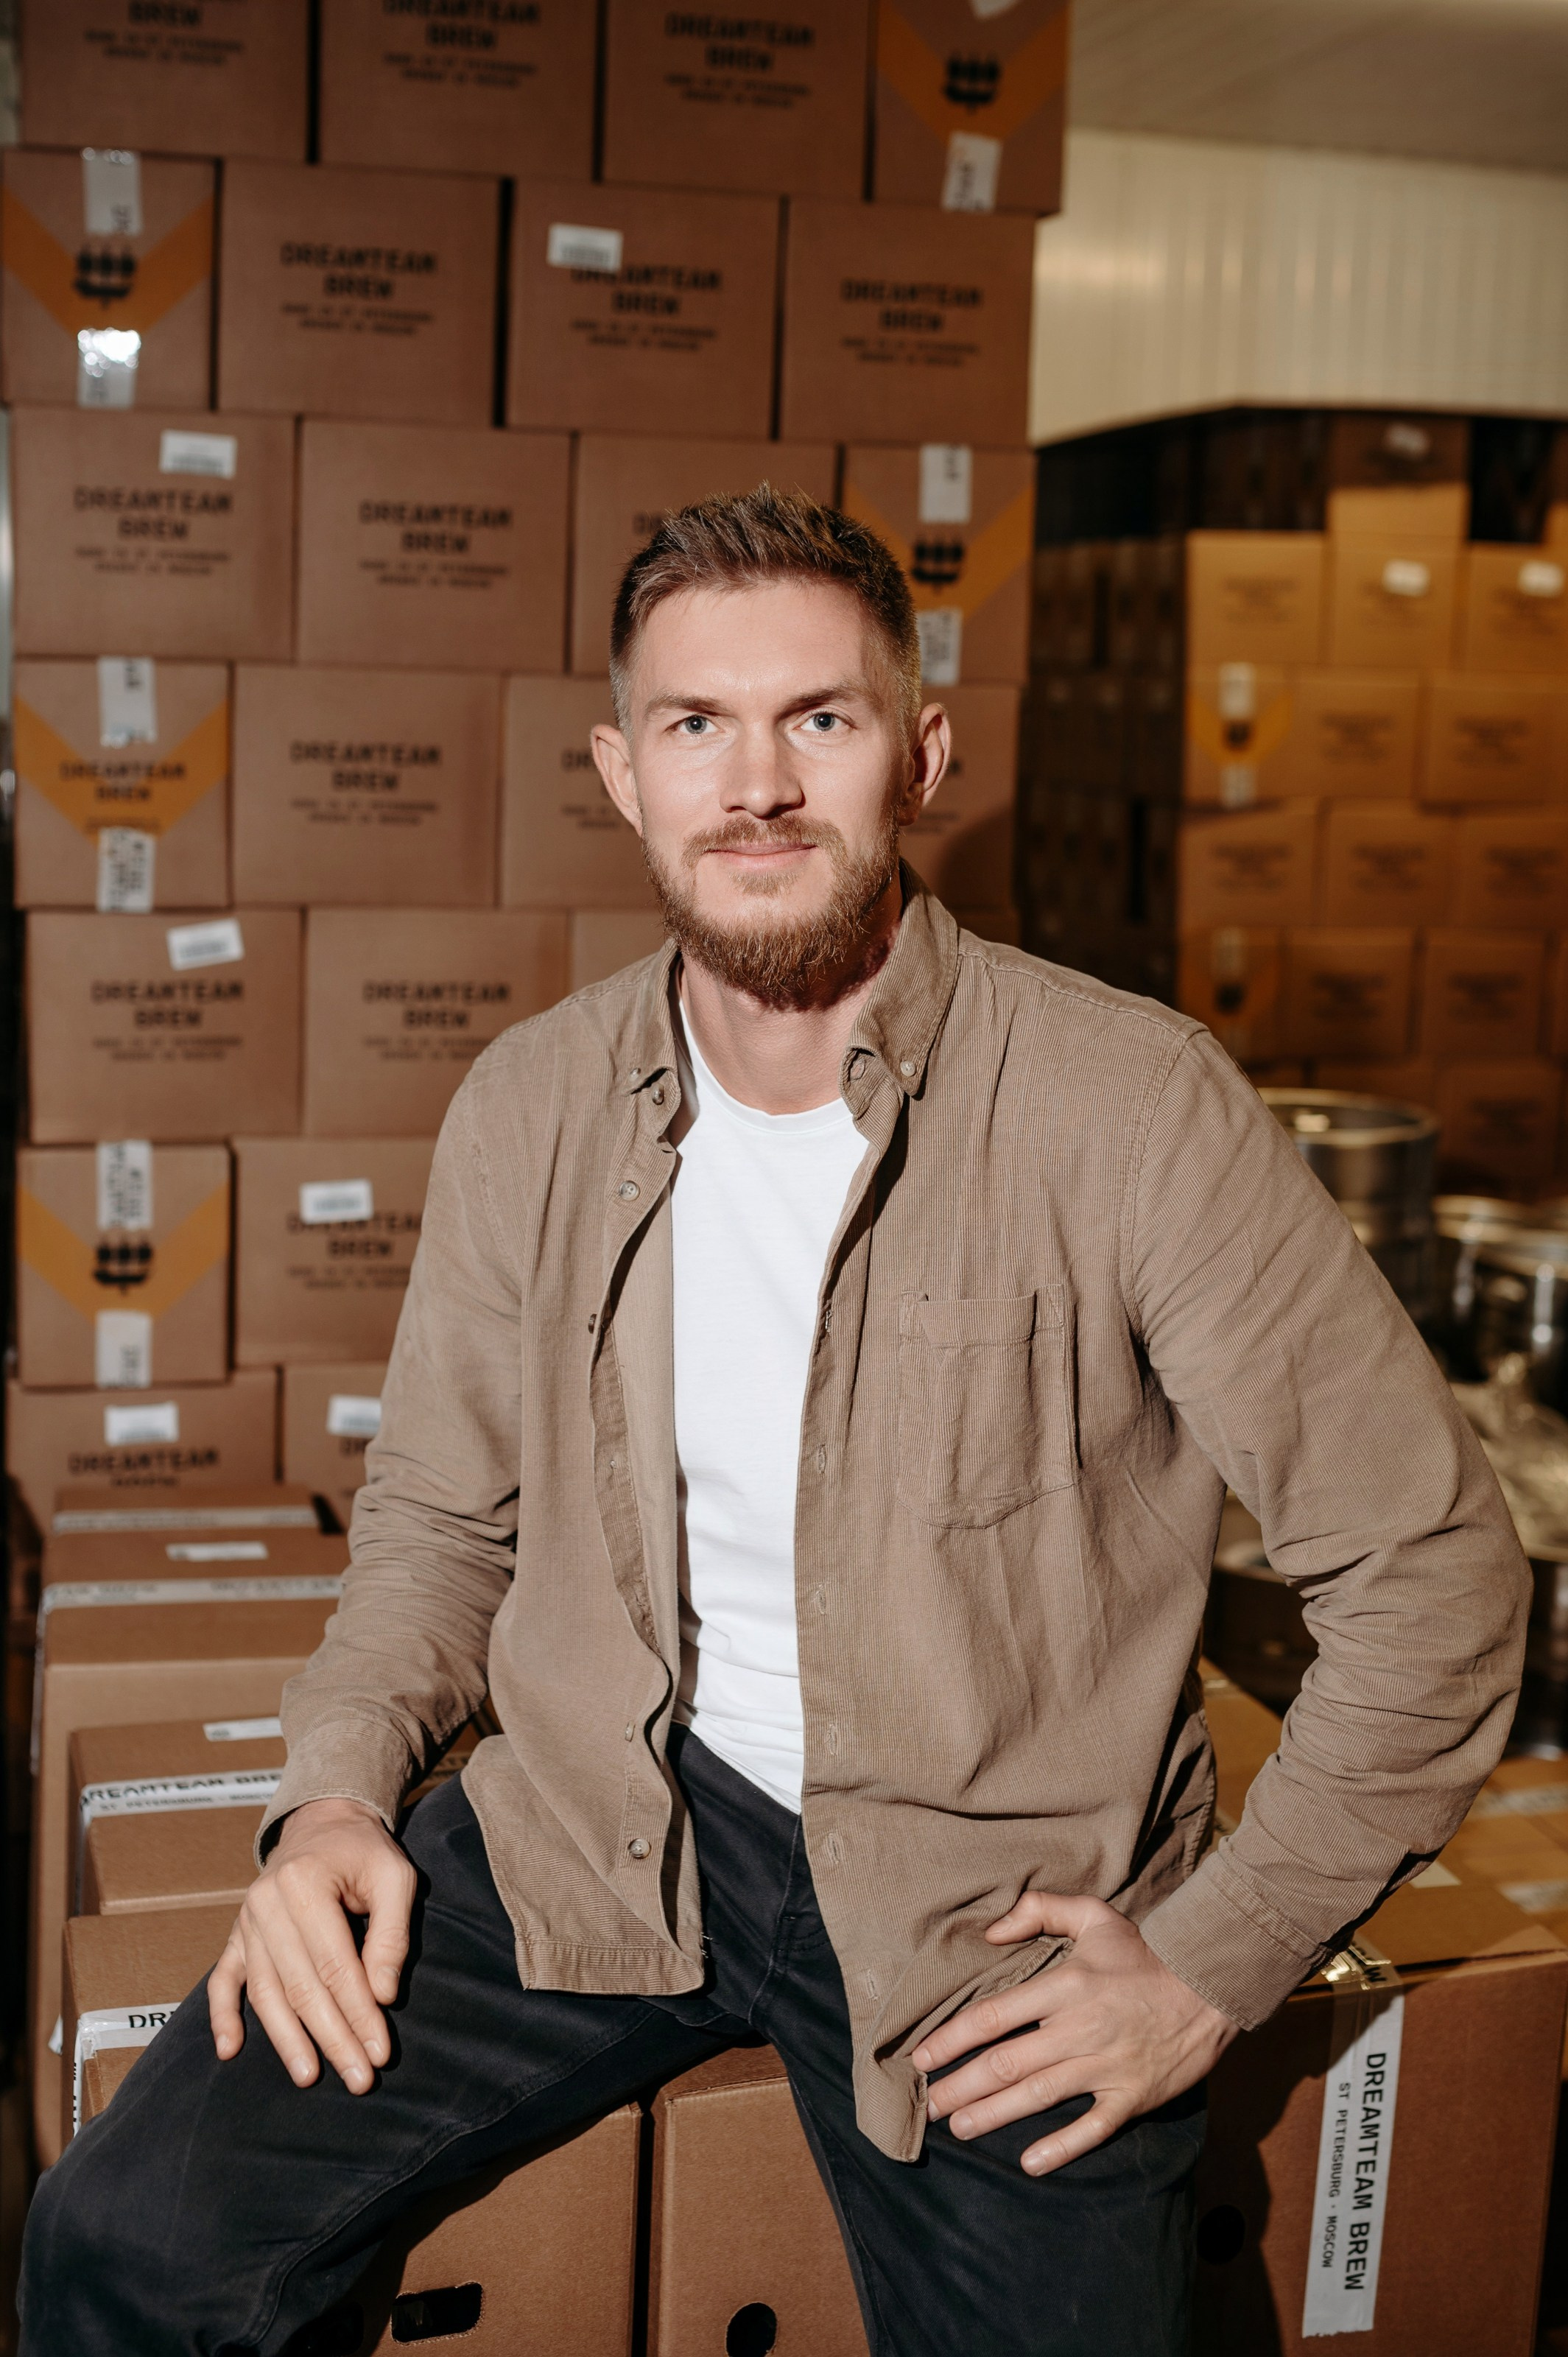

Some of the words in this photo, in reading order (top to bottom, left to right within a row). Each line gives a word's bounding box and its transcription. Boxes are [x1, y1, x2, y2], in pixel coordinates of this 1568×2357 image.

[426, 24, 497, 49] BREW
[706, 45, 773, 71] BREW
[280, 242, 438, 274] DREAMTEAM
[324, 275, 393, 299] BREW
[611, 292, 681, 316] BREW
[879, 309, 944, 332] BREW
[74, 485, 233, 515] DREAMTEAM
[359, 501, 513, 529] DREAMTEAM
[118, 517, 189, 541] BREW
[401, 531, 470, 554] BREW
[291, 741, 442, 767] DREAMTEAM
[59, 761, 187, 782] DREAMTEAM
[331, 770, 400, 792] BREW
[95, 786, 152, 804] BREW
[91, 980, 245, 1004] DREAMTEAM
[363, 981, 511, 1003] DREAMTEAM
[135, 1008, 203, 1029] BREW
[403, 1008, 470, 1029] BREW
[327, 1239, 394, 1259] BREW
[68, 1447, 221, 1474] DREAMTEAM
[235, 1772, 282, 1784] BRE
[128, 2011, 177, 2028] DR
[1339, 2082, 1351, 2100] ST
[1352, 2053, 1387, 2210] DREAMTEAM
[1329, 2110, 1349, 2199] PETERSBURG
[1322, 2215, 1337, 2268] MOSCOW
[1345, 2221, 1370, 2290] BREW
